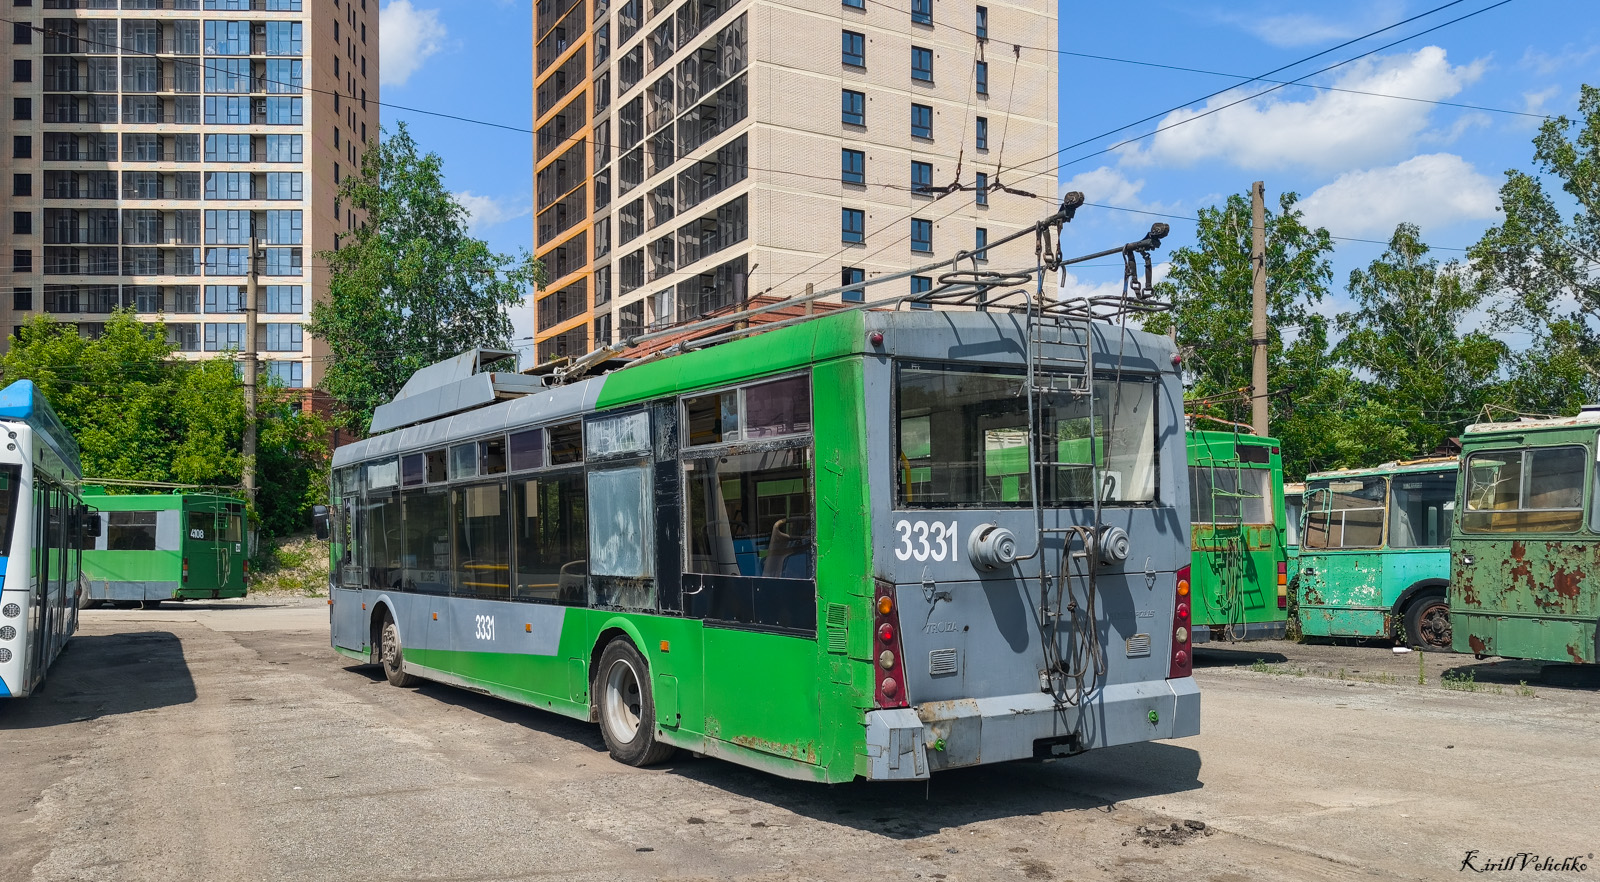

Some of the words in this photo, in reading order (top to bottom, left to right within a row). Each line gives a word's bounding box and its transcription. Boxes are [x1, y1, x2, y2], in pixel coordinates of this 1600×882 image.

[190, 529, 204, 539] 4108
[895, 519, 958, 562] 3331
[475, 614, 495, 641] 3331
